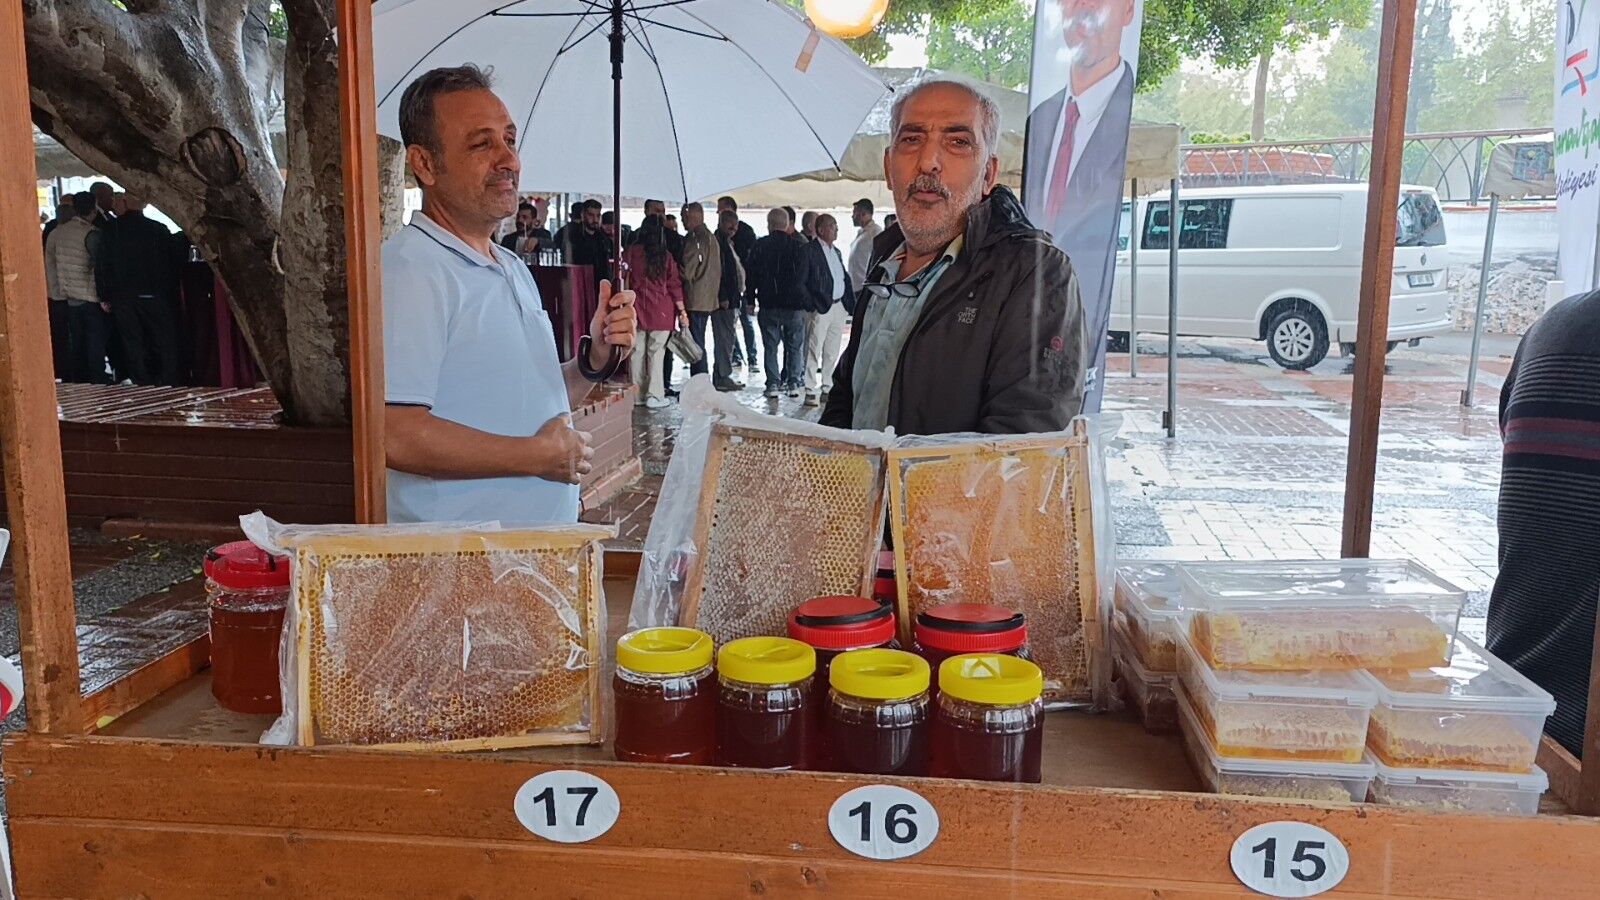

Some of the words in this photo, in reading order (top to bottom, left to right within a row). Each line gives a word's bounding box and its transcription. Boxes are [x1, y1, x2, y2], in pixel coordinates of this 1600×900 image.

[533, 787, 599, 827] 17
[848, 801, 918, 844] 16
[1252, 837, 1327, 882] 15
